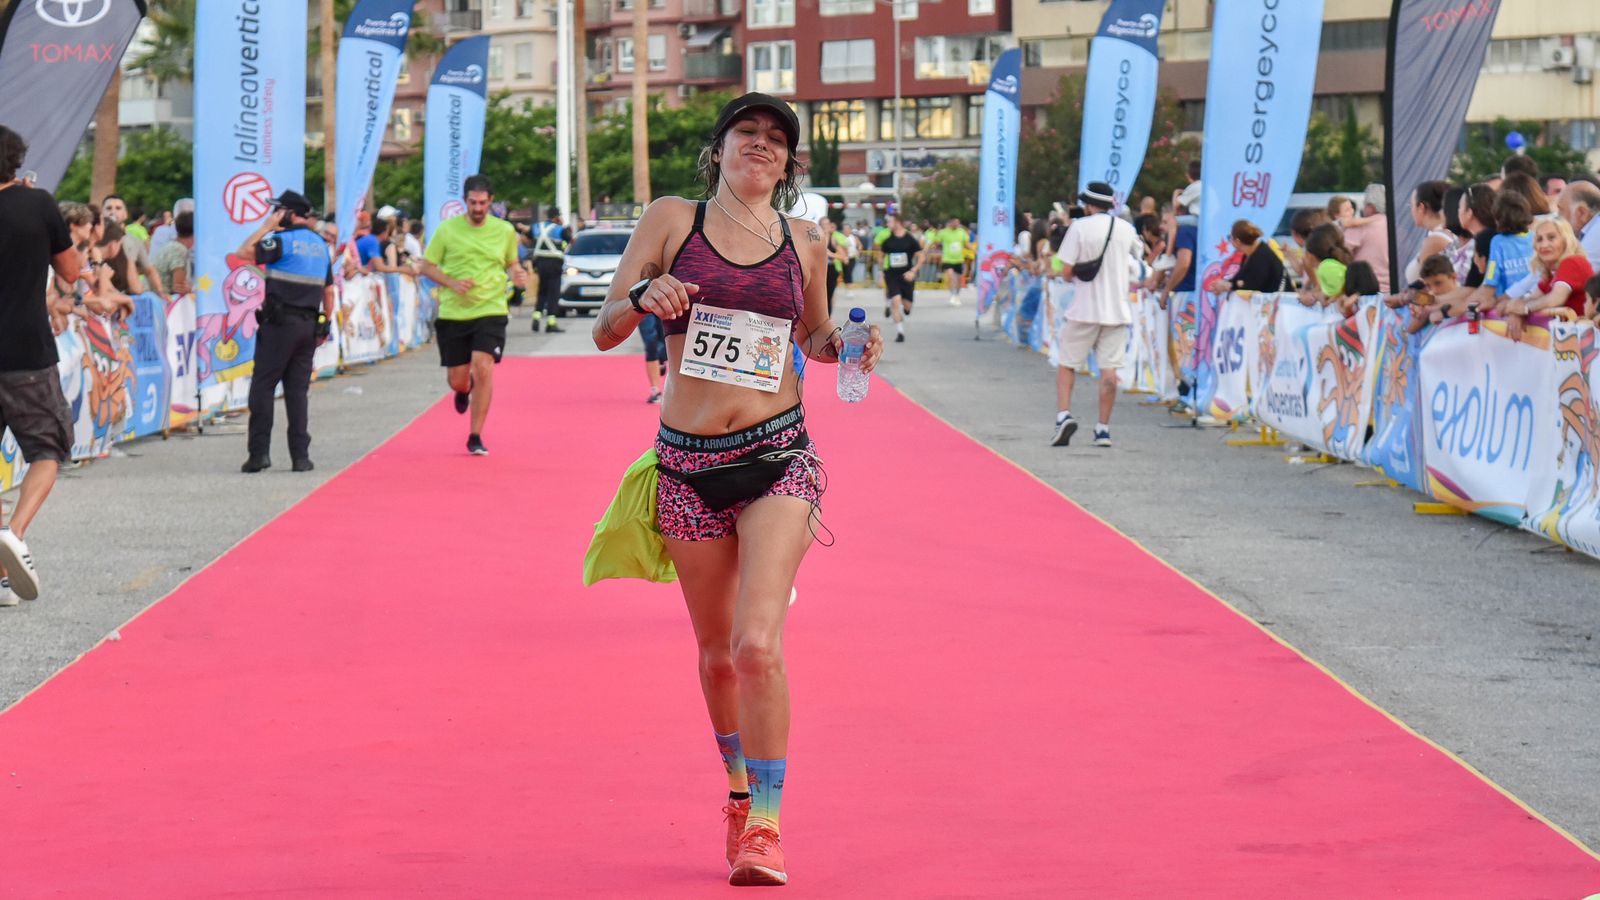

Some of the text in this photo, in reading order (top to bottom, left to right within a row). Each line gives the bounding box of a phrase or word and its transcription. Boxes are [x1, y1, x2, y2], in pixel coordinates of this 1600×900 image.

[1422, 0, 1494, 33] TOMAX
[30, 43, 117, 64] TOMAX
[1104, 58, 1133, 186] Sergeyco
[694, 311, 714, 323] XXI
[693, 330, 742, 363] 575
[703, 433, 745, 450] ARMOUR
[764, 409, 799, 434] ARMOUR
